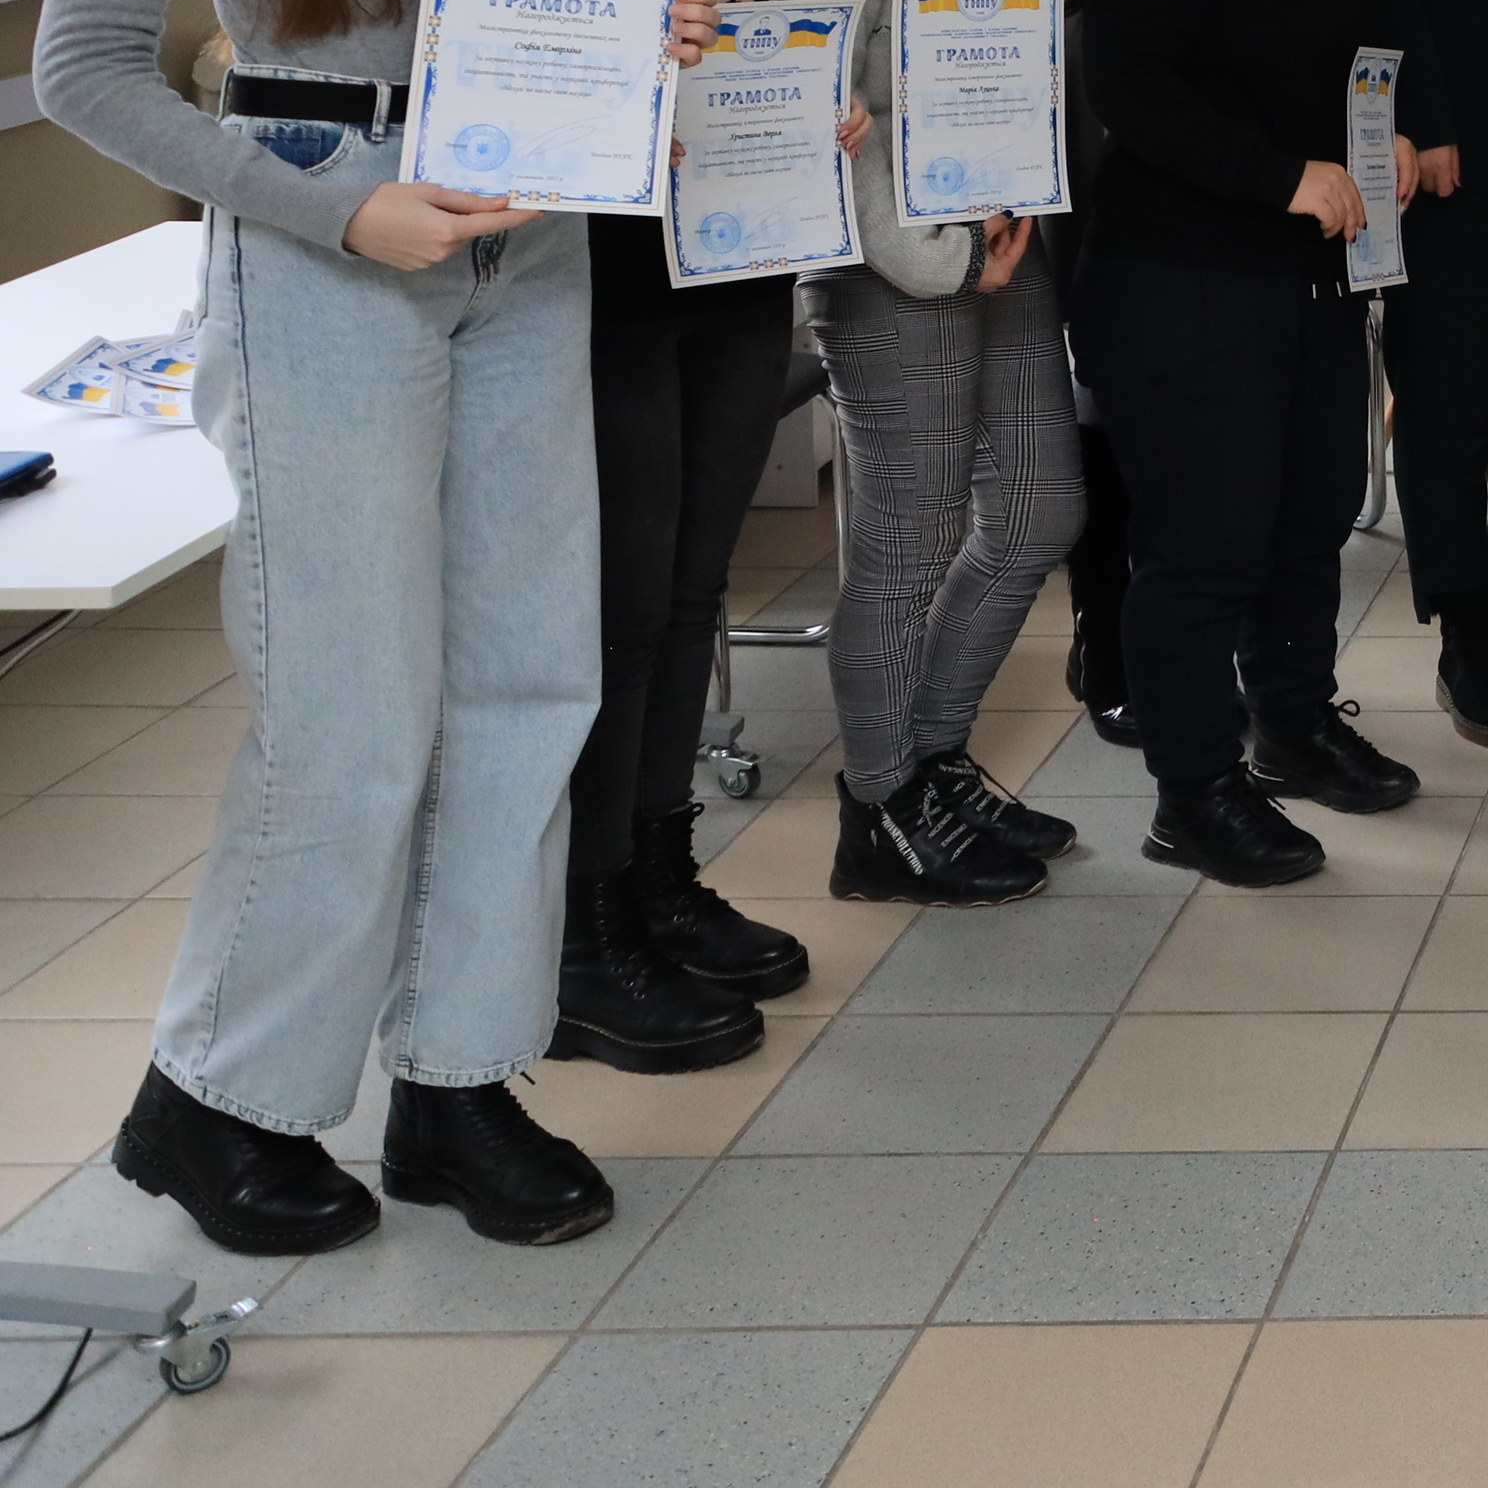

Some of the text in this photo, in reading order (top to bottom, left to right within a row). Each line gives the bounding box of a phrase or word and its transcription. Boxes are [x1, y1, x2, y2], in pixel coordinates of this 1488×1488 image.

[516, 10, 594, 25] Нагороджується
[514, 41, 541, 53] Софія
[741, 37, 781, 49] ТНПУ
[936, 46, 1020, 62] ГРАМОТА
[708, 87, 802, 107] ГРАМОТА
